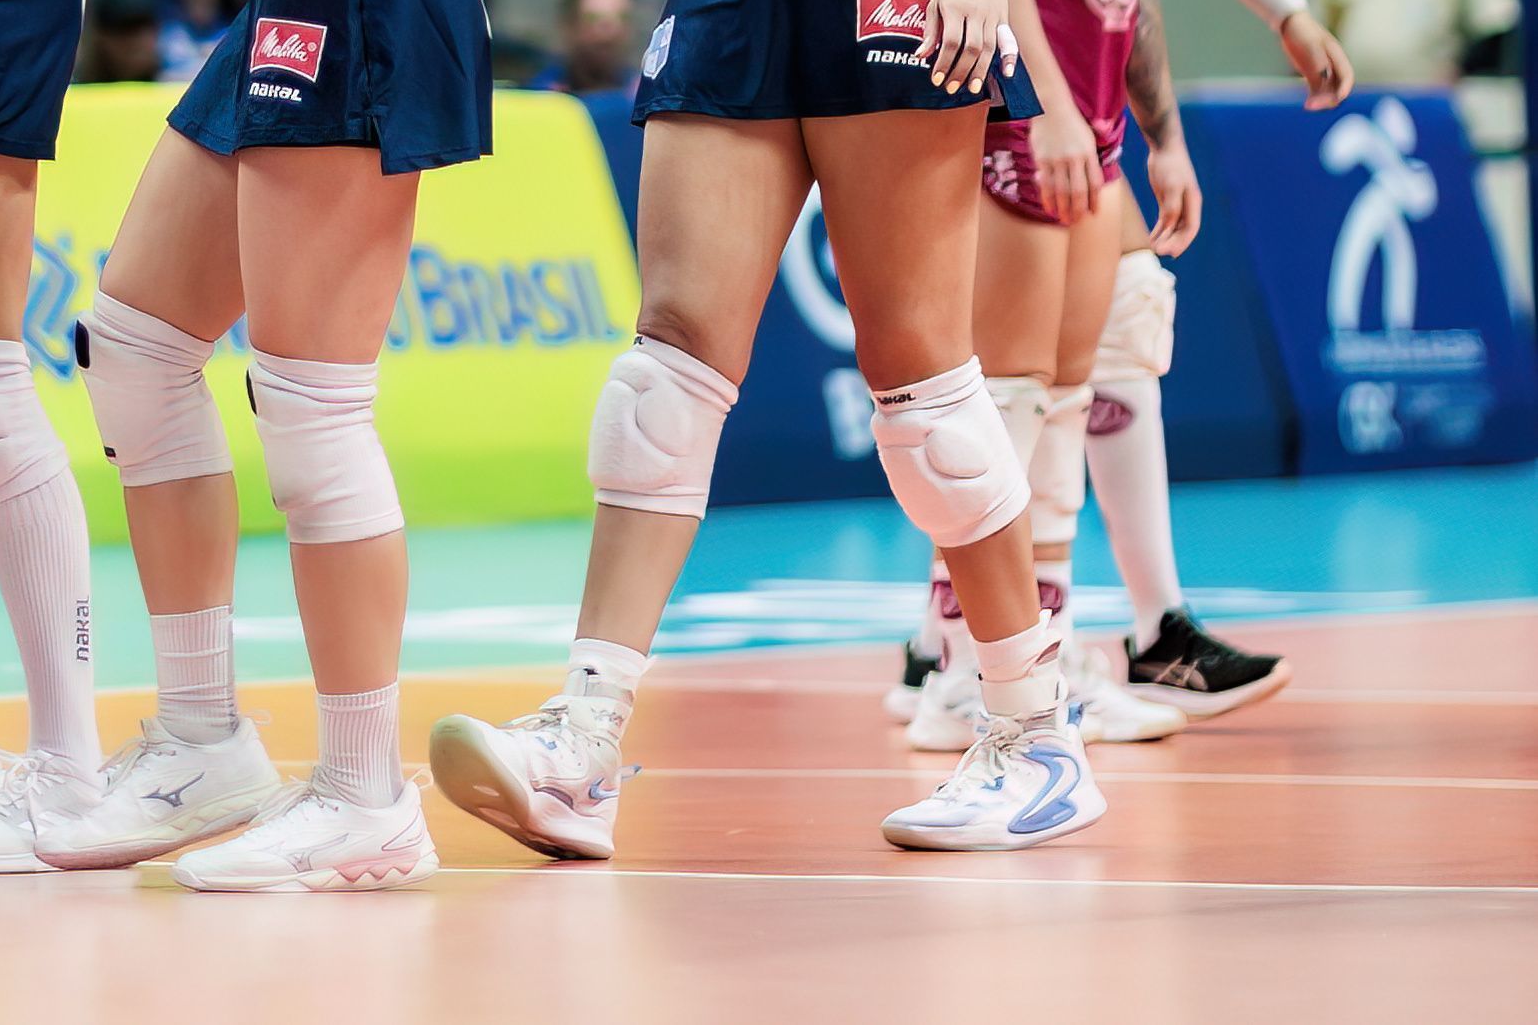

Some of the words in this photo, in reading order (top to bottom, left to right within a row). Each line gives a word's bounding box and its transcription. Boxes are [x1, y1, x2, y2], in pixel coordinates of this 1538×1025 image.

[257, 27, 308, 62] Melitta
[248, 82, 302, 102] nakal
[75, 593, 90, 662] nakal
